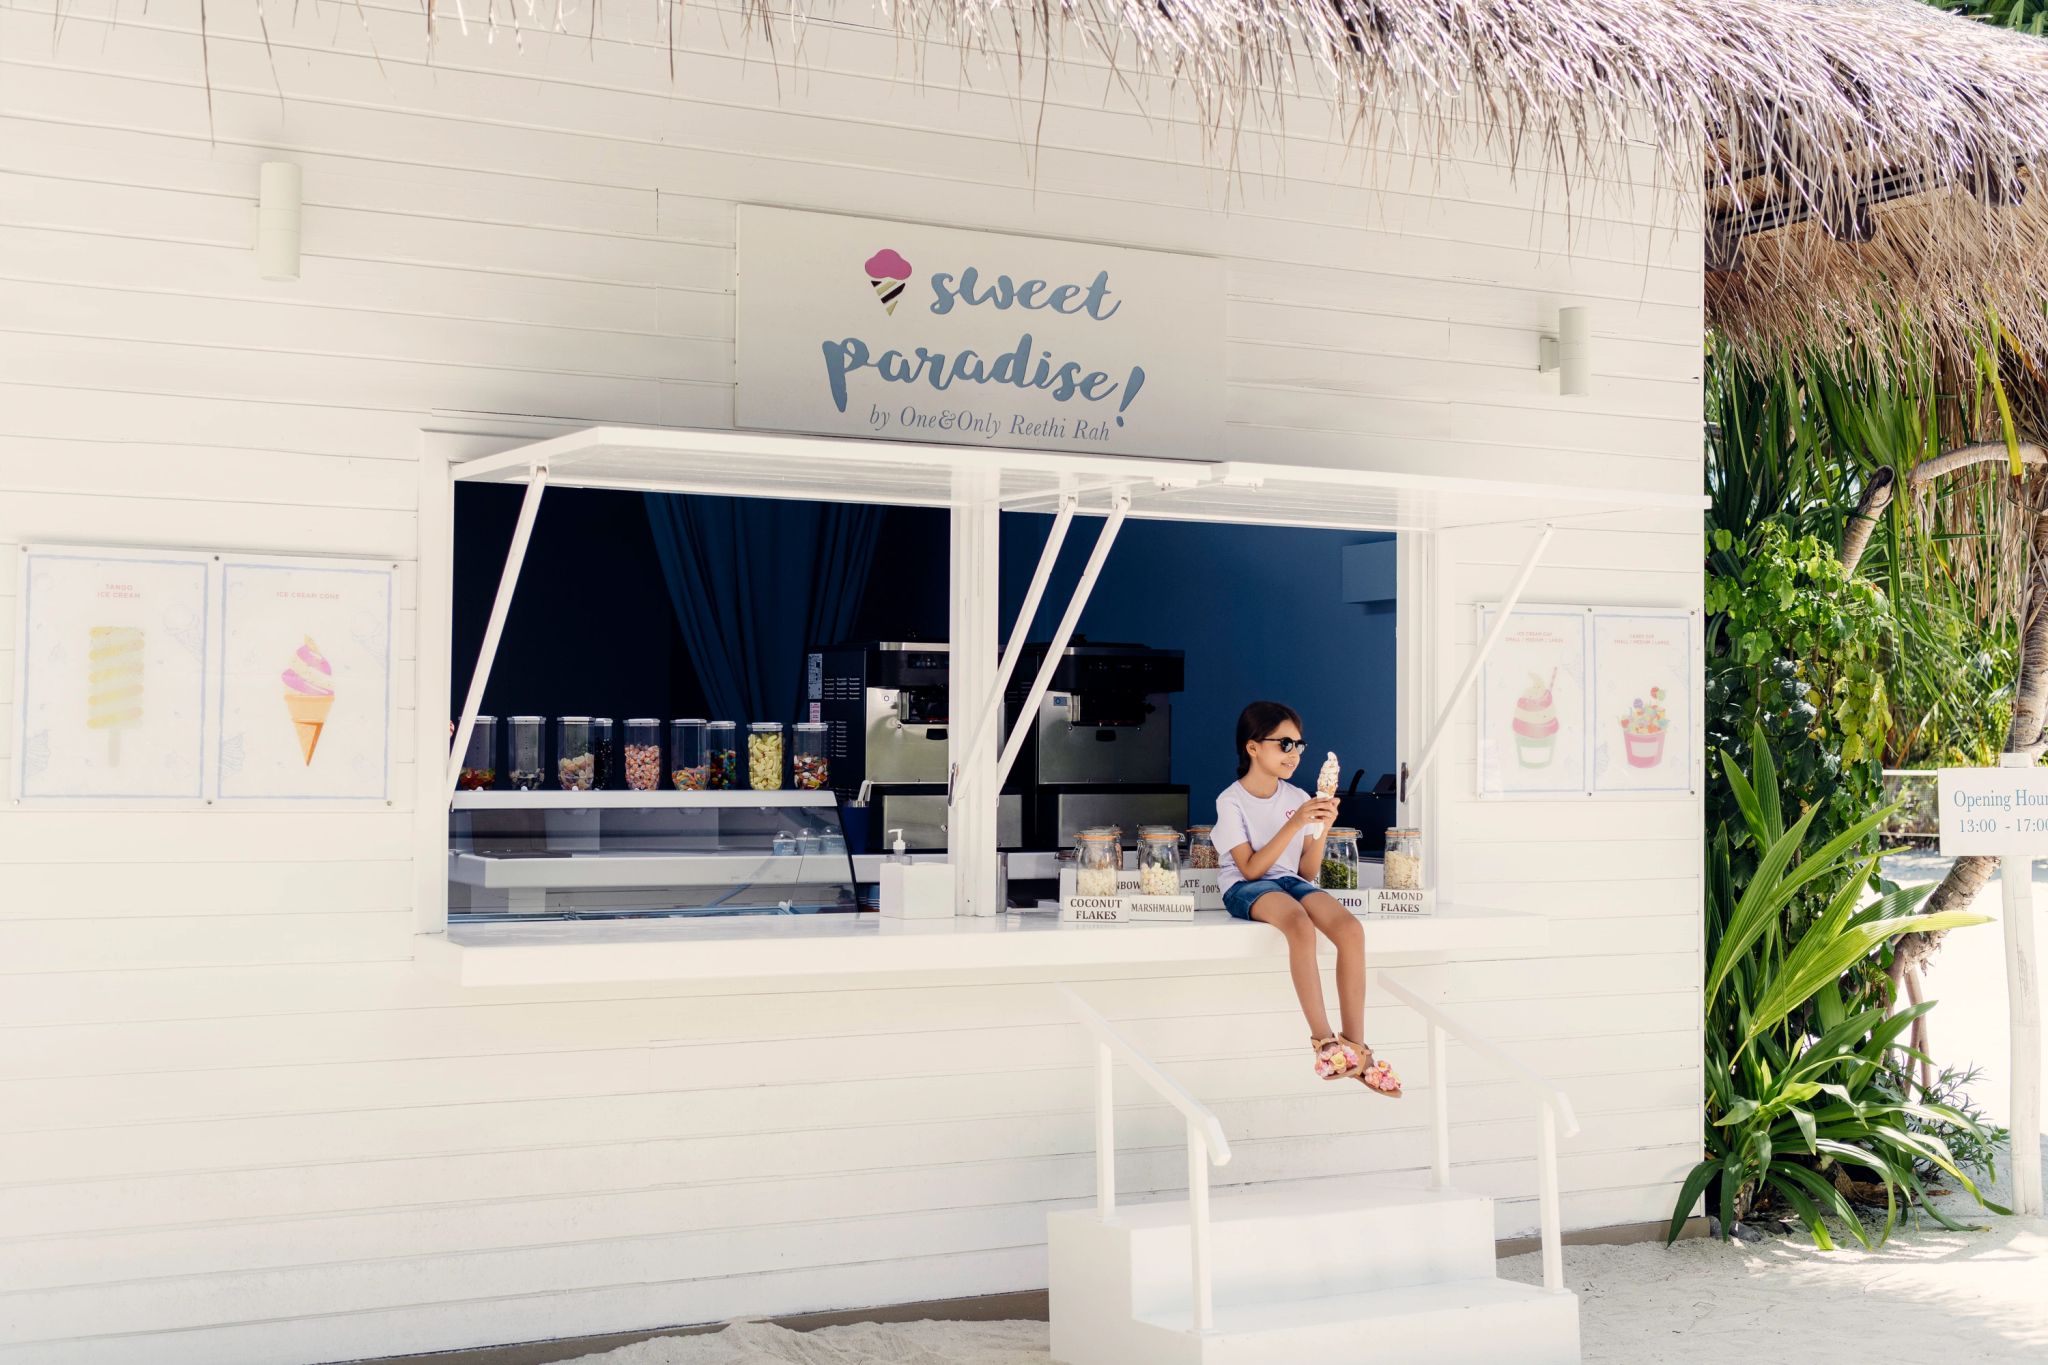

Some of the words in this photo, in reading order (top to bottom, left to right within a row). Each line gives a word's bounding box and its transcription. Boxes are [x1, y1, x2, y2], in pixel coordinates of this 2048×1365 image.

[929, 266, 1122, 321] sweet
[821, 333, 1146, 428] paradise!
[869, 404, 891, 431] by
[900, 405, 1002, 439] One&Only
[1010, 414, 1067, 439] Reethi
[1072, 418, 1111, 441] Rah
[290, 592, 317, 600] CREAM
[1953, 789, 2012, 812] Opening
[1959, 818, 1997, 833] 13:00
[1377, 890, 1423, 902] ALMOND
[1070, 898, 1123, 909] COCONUT
[1130, 903, 1193, 914] MARSHMALLOW
[1380, 902, 1420, 913] FLAKES
[1075, 910, 1117, 920] FLAKES
